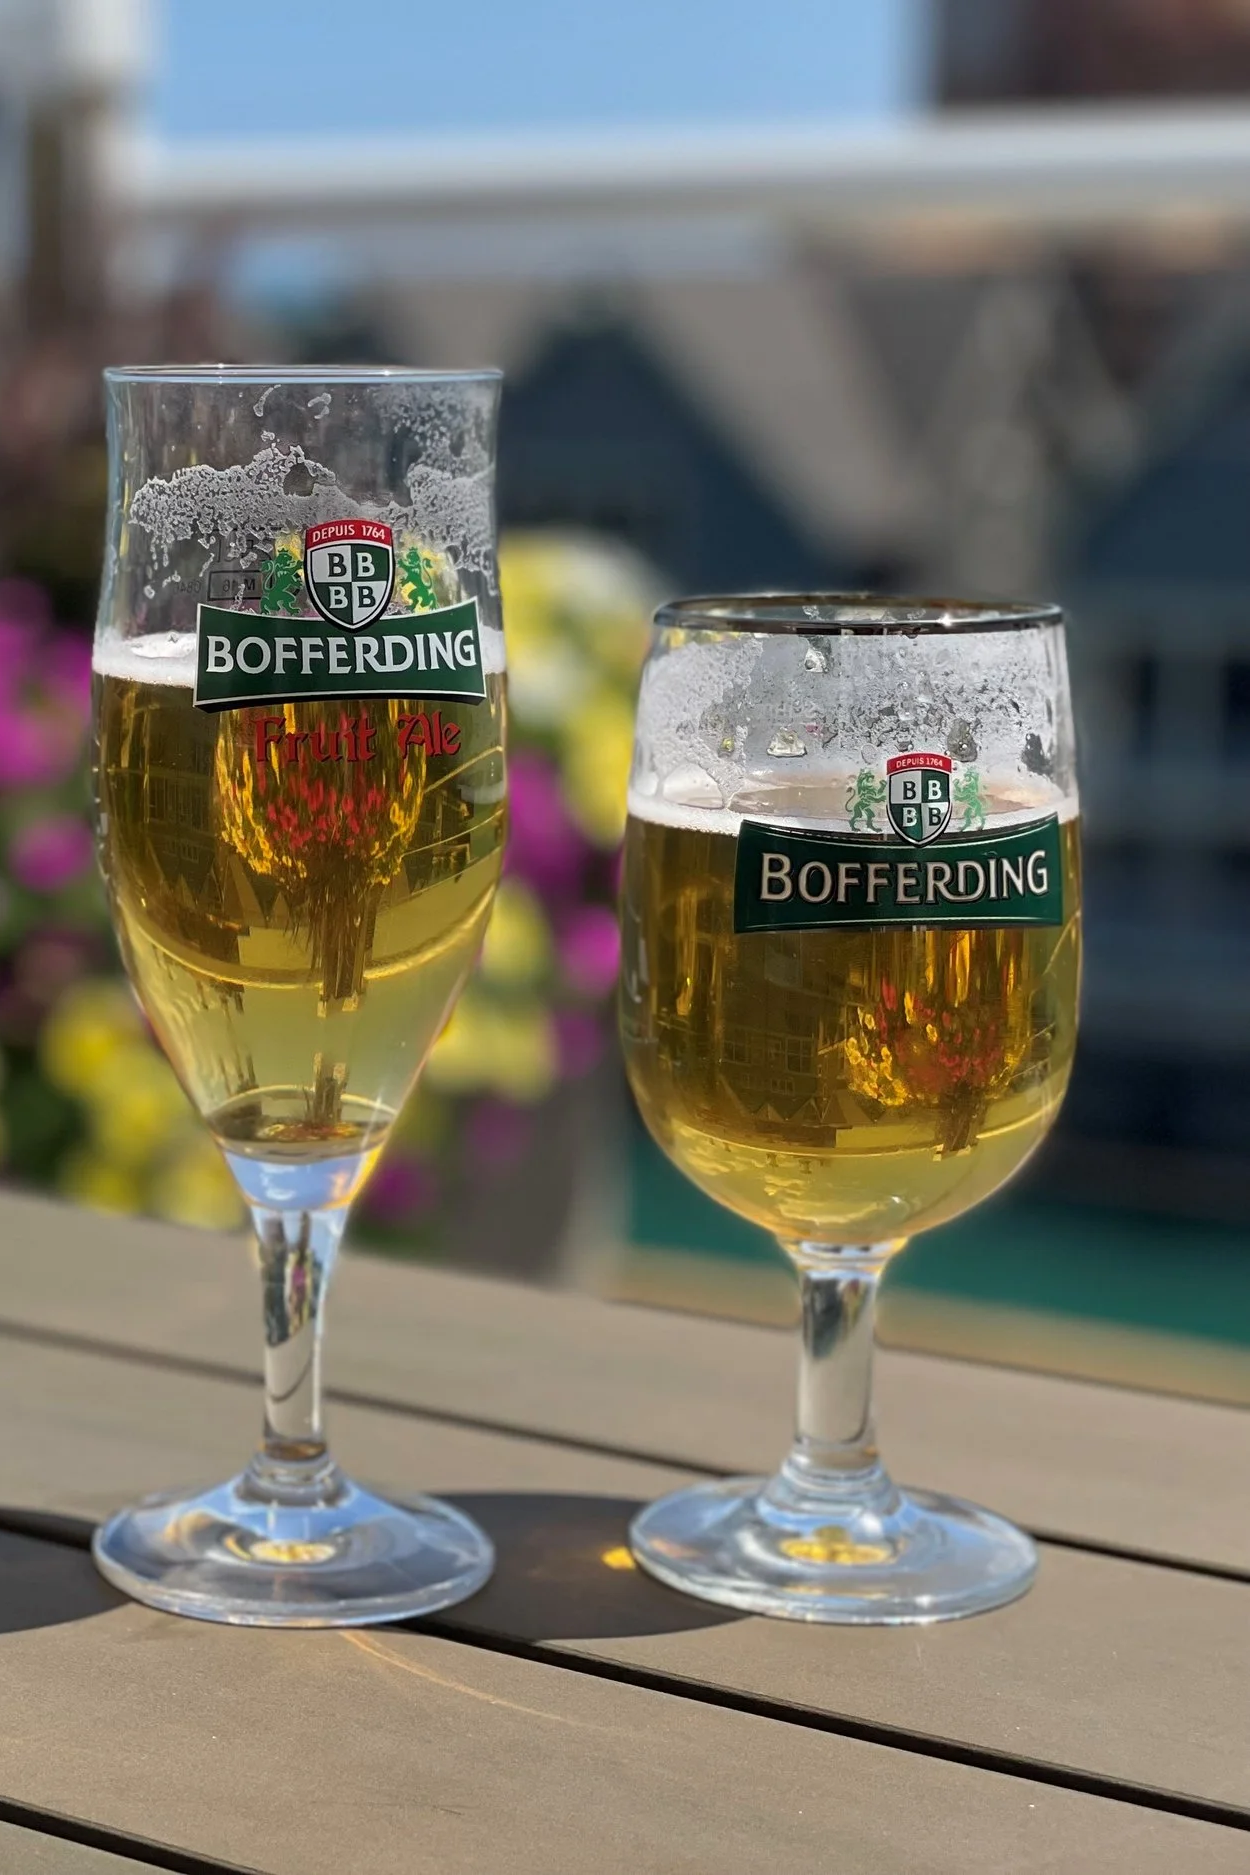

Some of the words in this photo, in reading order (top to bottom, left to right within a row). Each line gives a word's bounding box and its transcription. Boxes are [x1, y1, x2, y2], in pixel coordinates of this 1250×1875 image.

[312, 524, 355, 542] DEPUIS
[362, 524, 385, 540] 1764
[206, 629, 478, 675] BOFFERDING
[252, 714, 377, 763] Fruit
[398, 710, 462, 757] Ale
[896, 758, 925, 769] DEPUIS
[926, 757, 943, 767] 1764
[760, 850, 1049, 904] BOFFERDING
